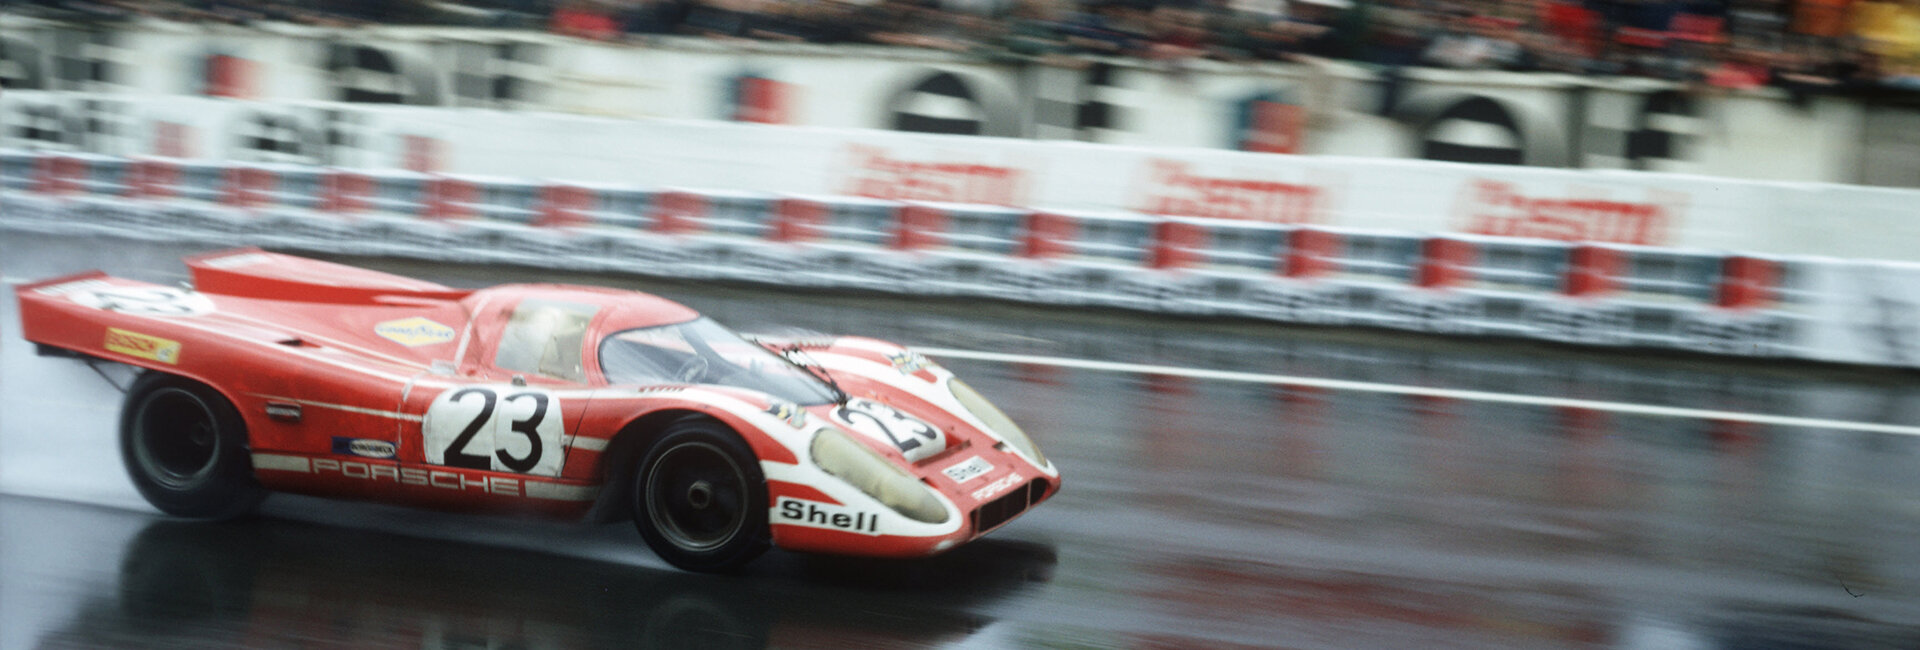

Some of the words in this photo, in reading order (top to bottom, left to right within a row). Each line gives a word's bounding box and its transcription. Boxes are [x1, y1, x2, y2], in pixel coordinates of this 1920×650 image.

[444, 388, 549, 473] 23
[837, 399, 937, 452] 23
[313, 457, 520, 496] PORSCHE
[781, 500, 878, 532] Shell
